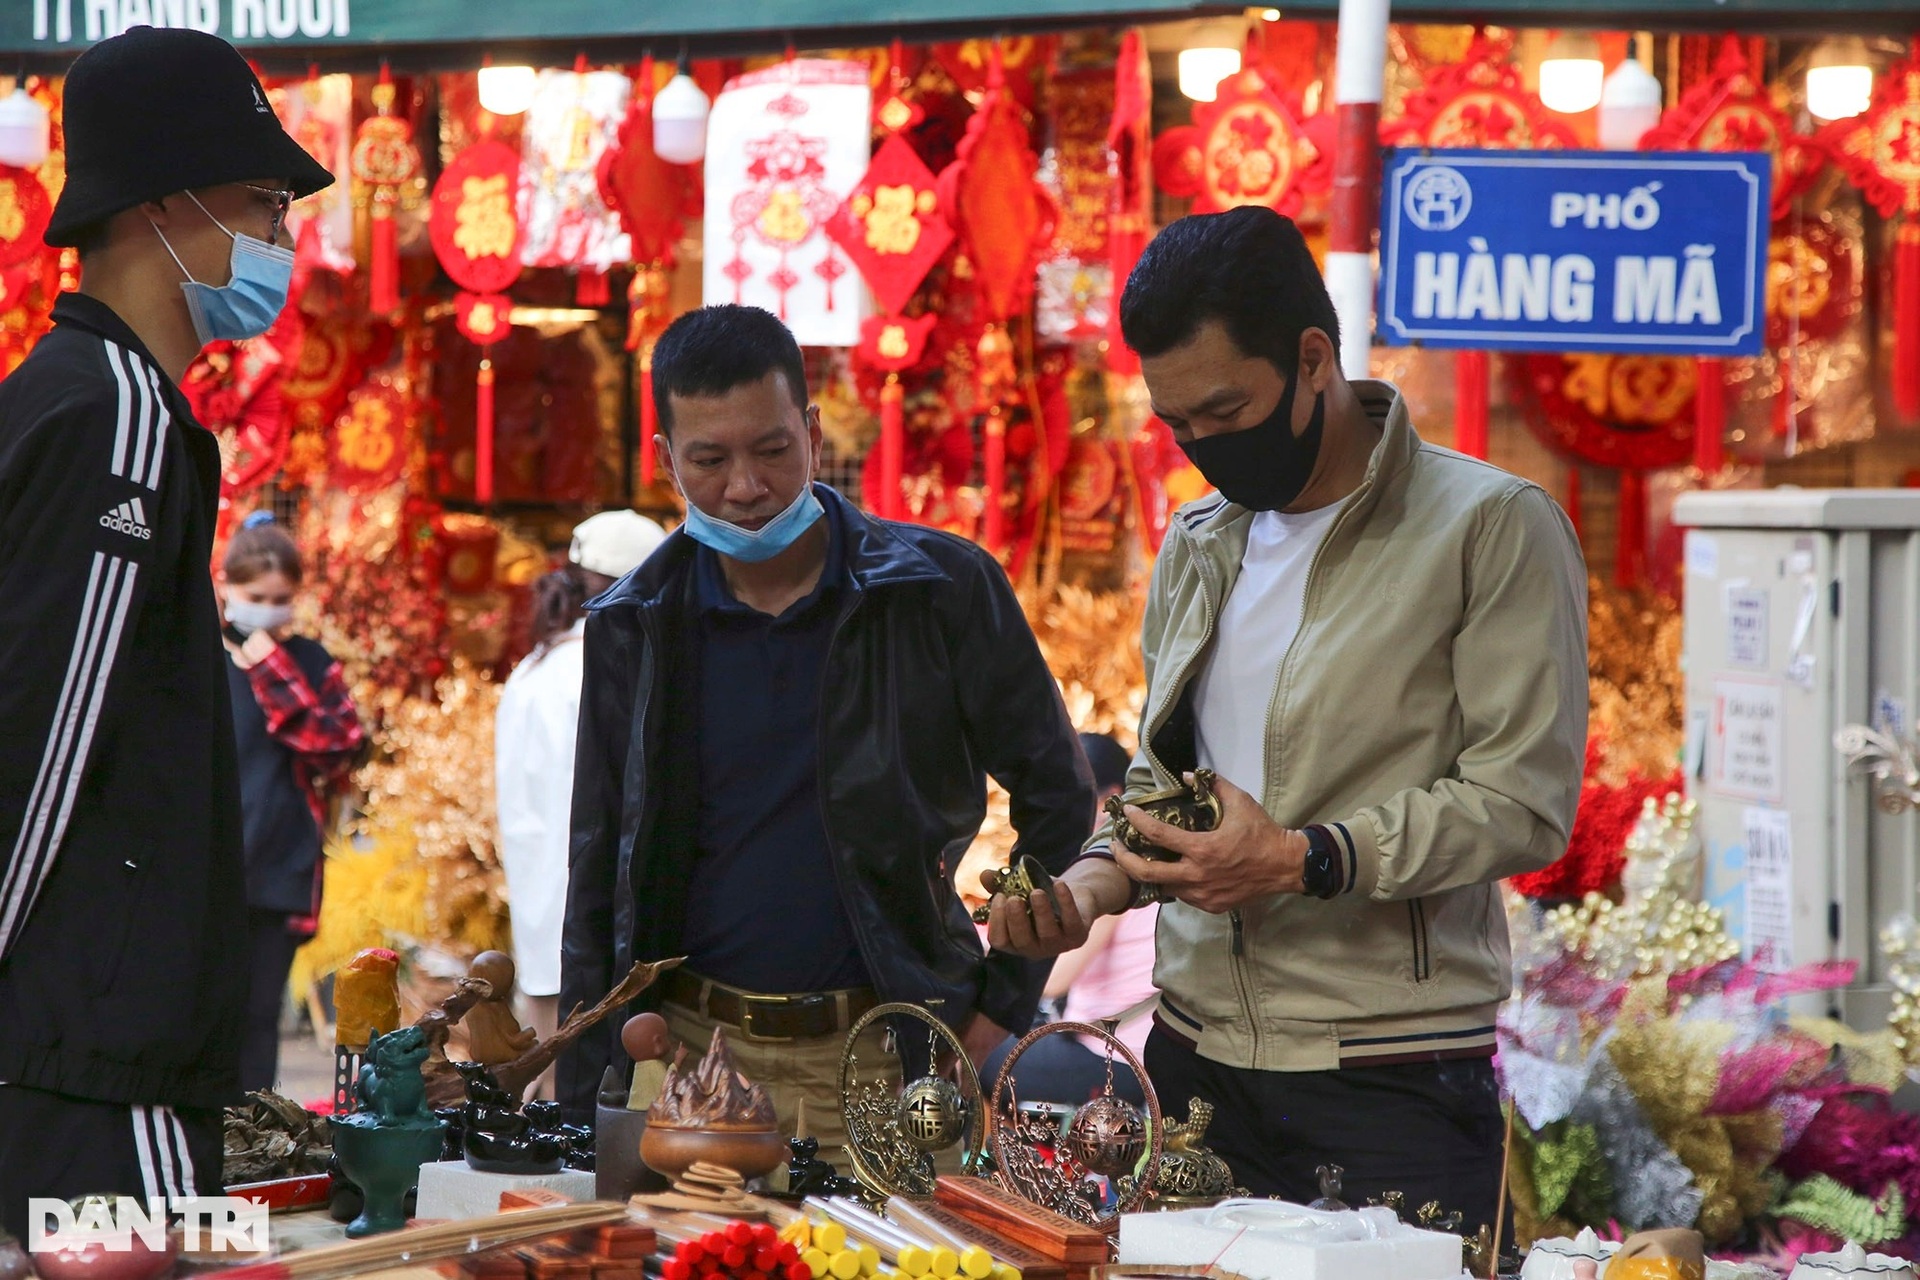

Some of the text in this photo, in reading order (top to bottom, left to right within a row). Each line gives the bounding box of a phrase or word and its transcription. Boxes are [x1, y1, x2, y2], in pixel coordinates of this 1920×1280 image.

[1550, 180, 1664, 231] PHỐ
[1412, 235, 1722, 325] HÀNG MÃ
[99, 515, 152, 540] adidas
